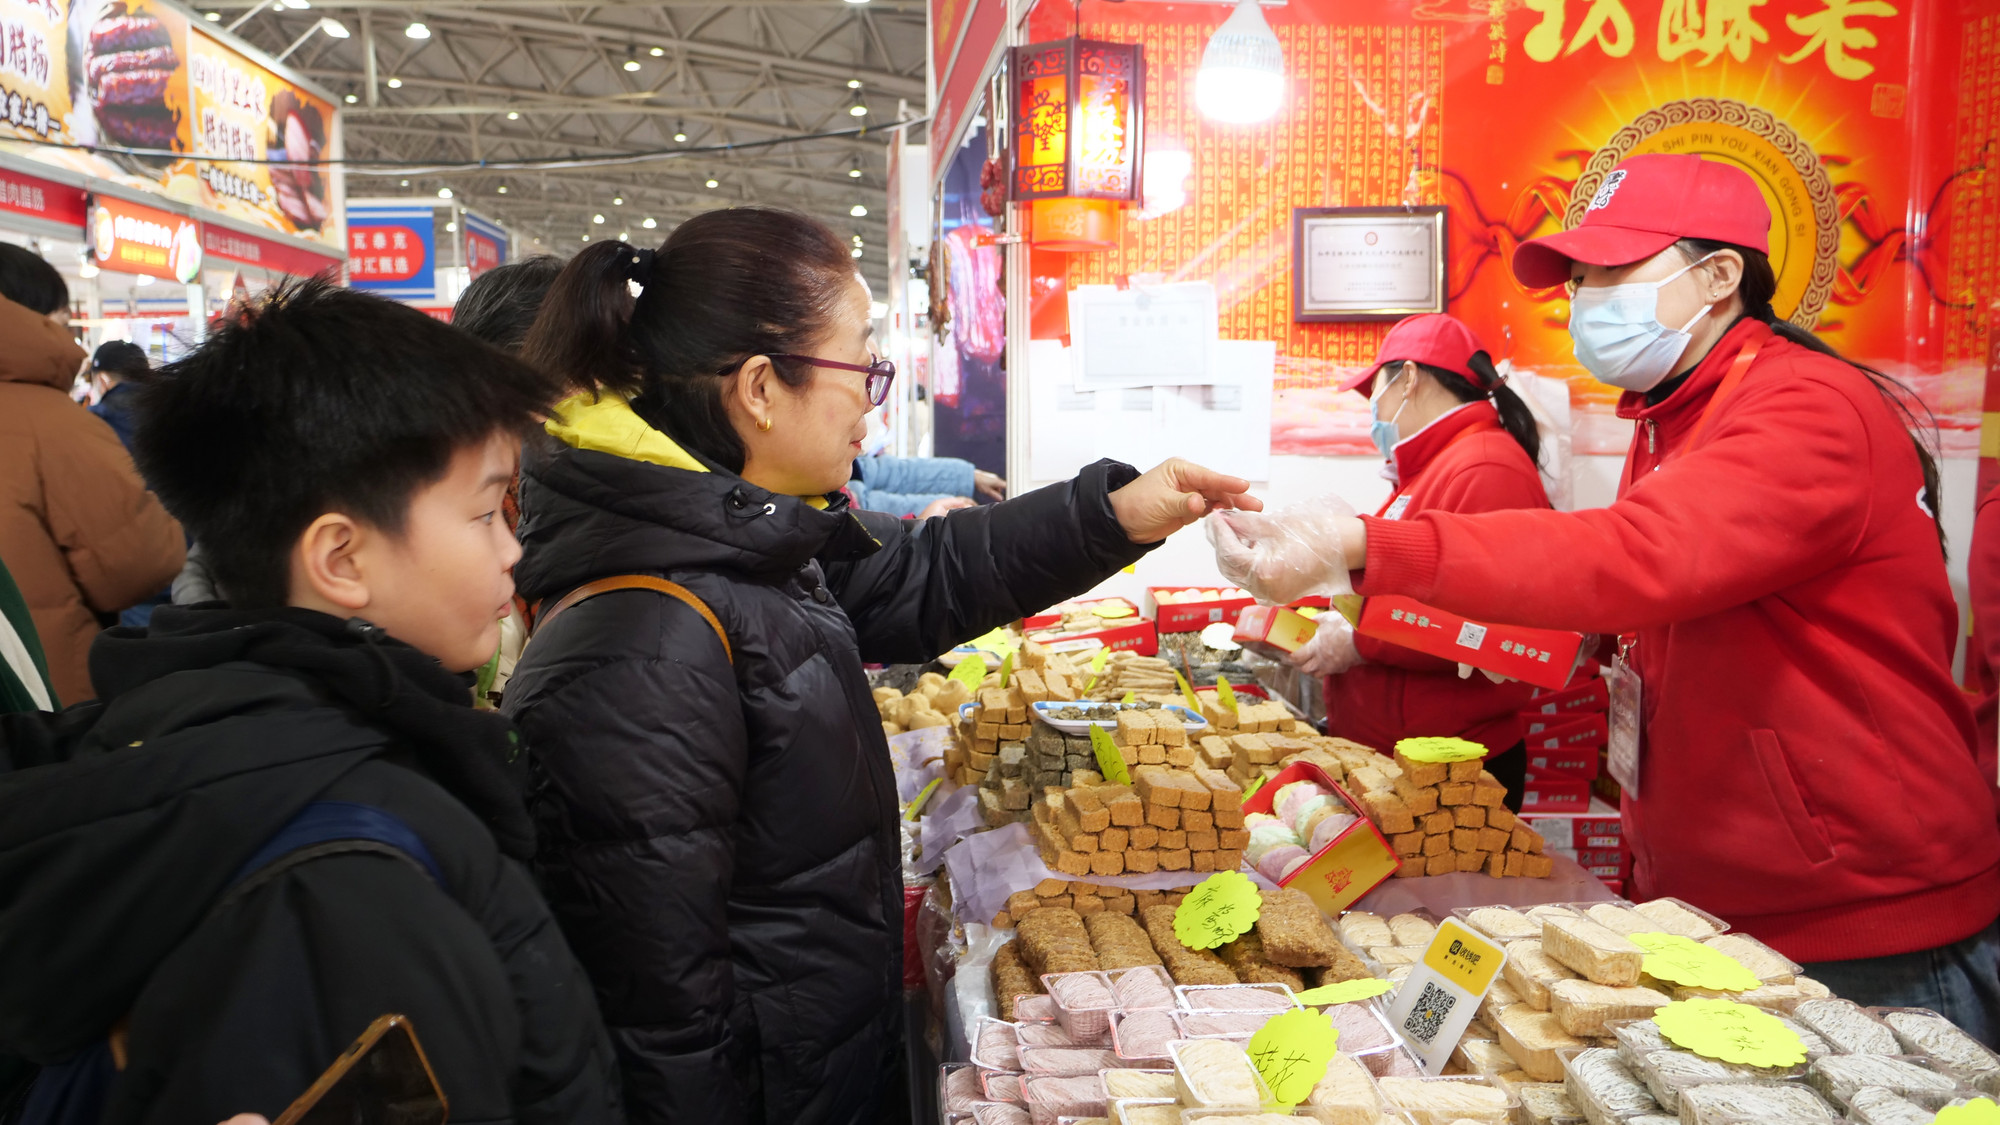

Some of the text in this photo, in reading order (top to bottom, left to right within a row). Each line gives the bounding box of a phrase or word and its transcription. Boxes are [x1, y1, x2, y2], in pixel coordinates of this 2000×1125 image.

[1662, 133, 1806, 238] SHI PIN YOU XIAN GONG SI
